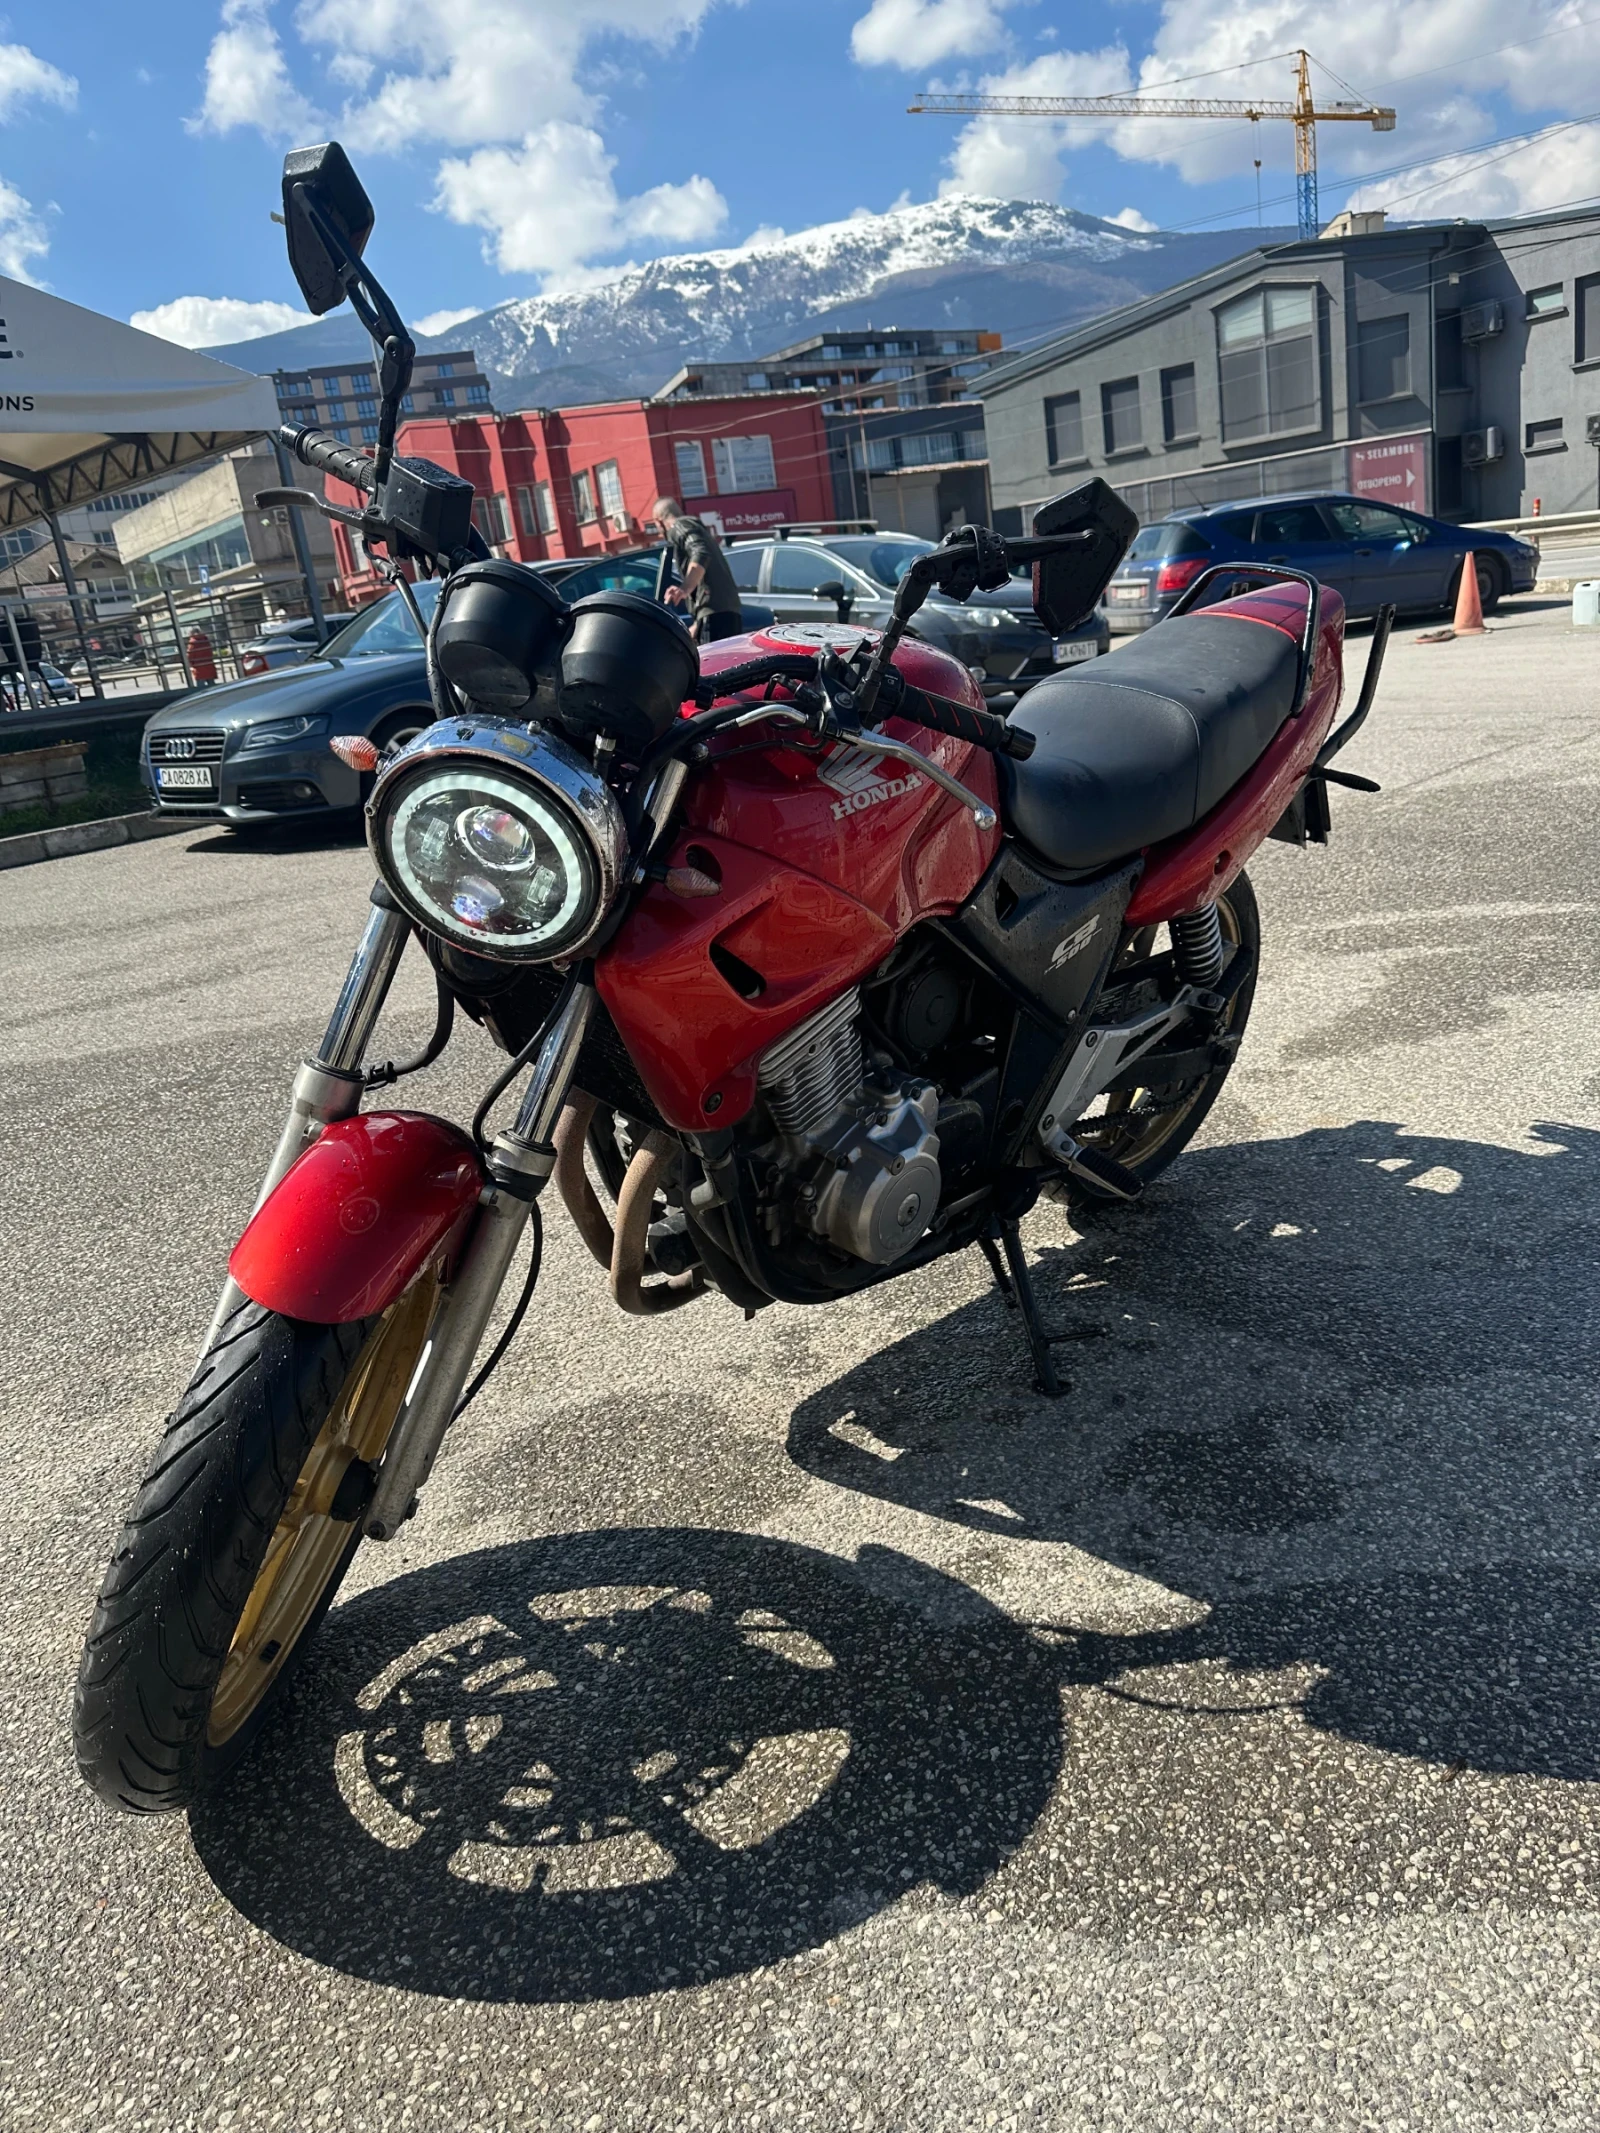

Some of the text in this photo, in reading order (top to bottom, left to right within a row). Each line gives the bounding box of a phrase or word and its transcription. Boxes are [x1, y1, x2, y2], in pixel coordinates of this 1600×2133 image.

[0, 396, 34, 411] NS
[1367, 443, 1415, 460] SELAMORE
[725, 512, 785, 526] m2-bg.com
[830, 773, 922, 820] HONDA
[1056, 934, 1092, 969] 500
